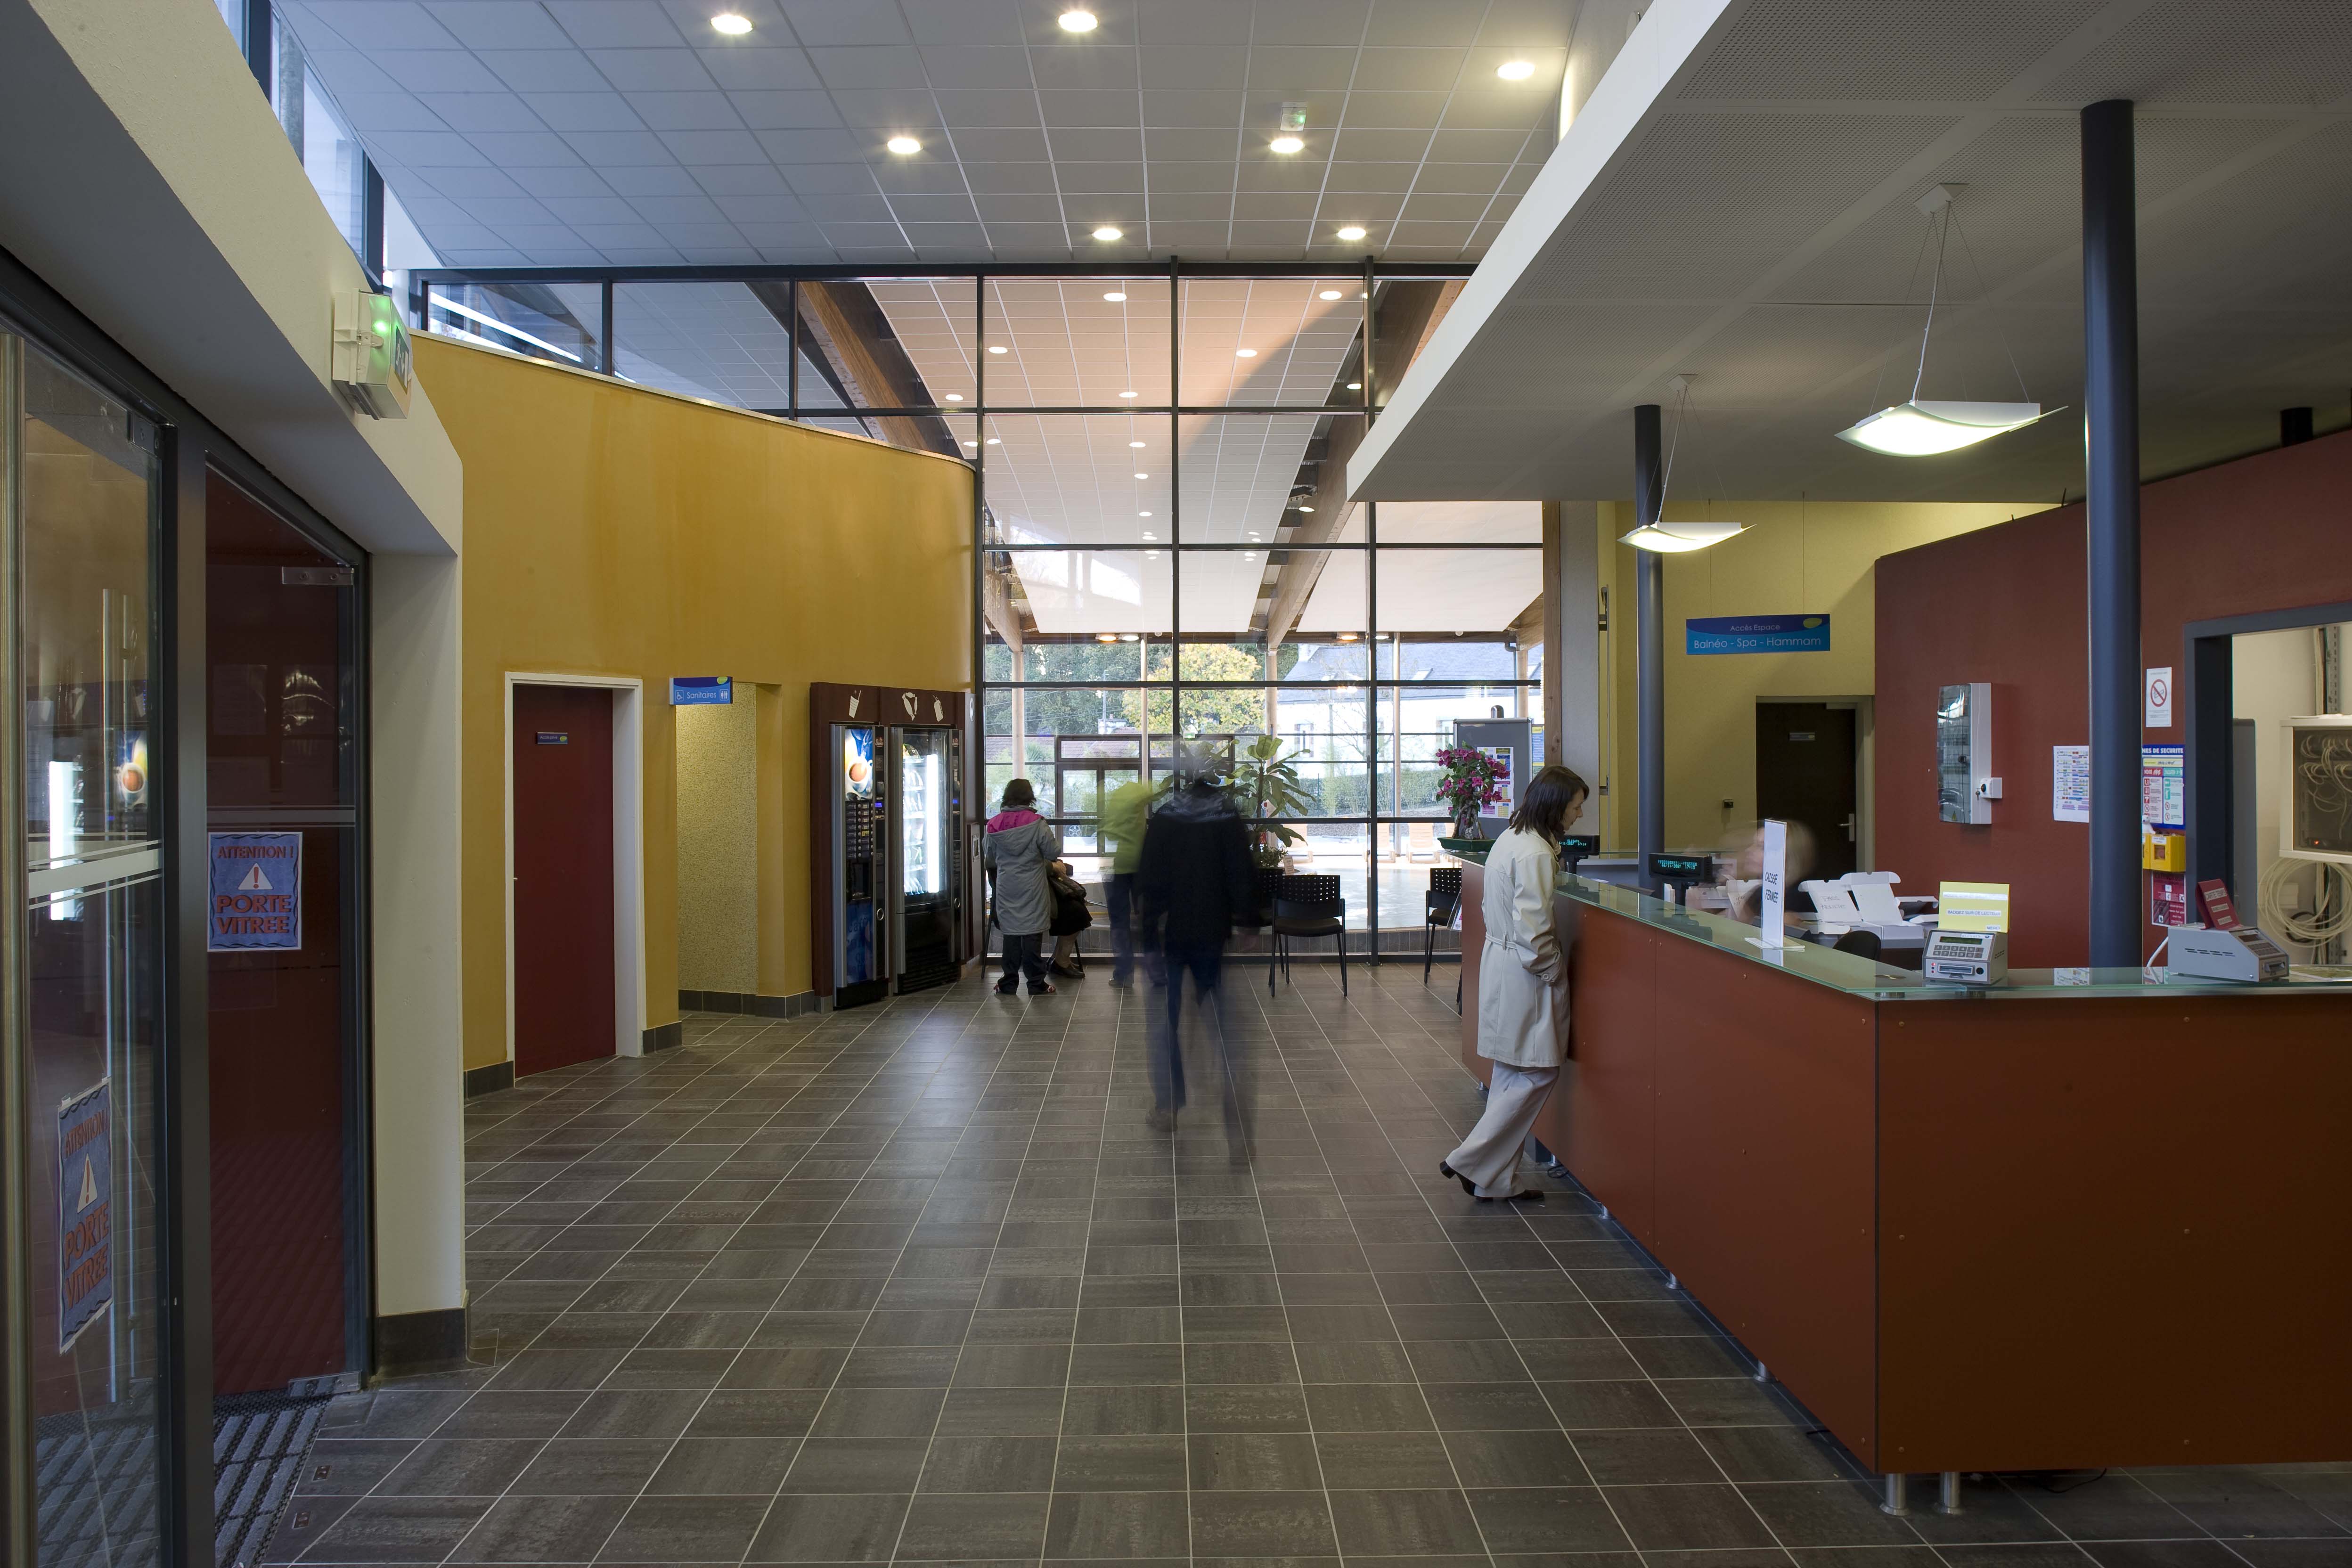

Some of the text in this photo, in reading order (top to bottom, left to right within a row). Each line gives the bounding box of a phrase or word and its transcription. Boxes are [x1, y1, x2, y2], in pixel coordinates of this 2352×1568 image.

[1694, 638, 1727, 649] Balnéo
[1737, 638, 1756, 649] Spa
[1767, 637, 1821, 646] Hammam
[217, 845, 294, 858] ATTENTION !
[1765, 872, 1778, 885] CAISSE
[216, 895, 292, 913] PORTE
[217, 916, 290, 934] VITREE
[65, 1110, 105, 1159] ATTENTION
[65, 1201, 109, 1271] PORTE
[65, 1244, 108, 1309] VITREE
